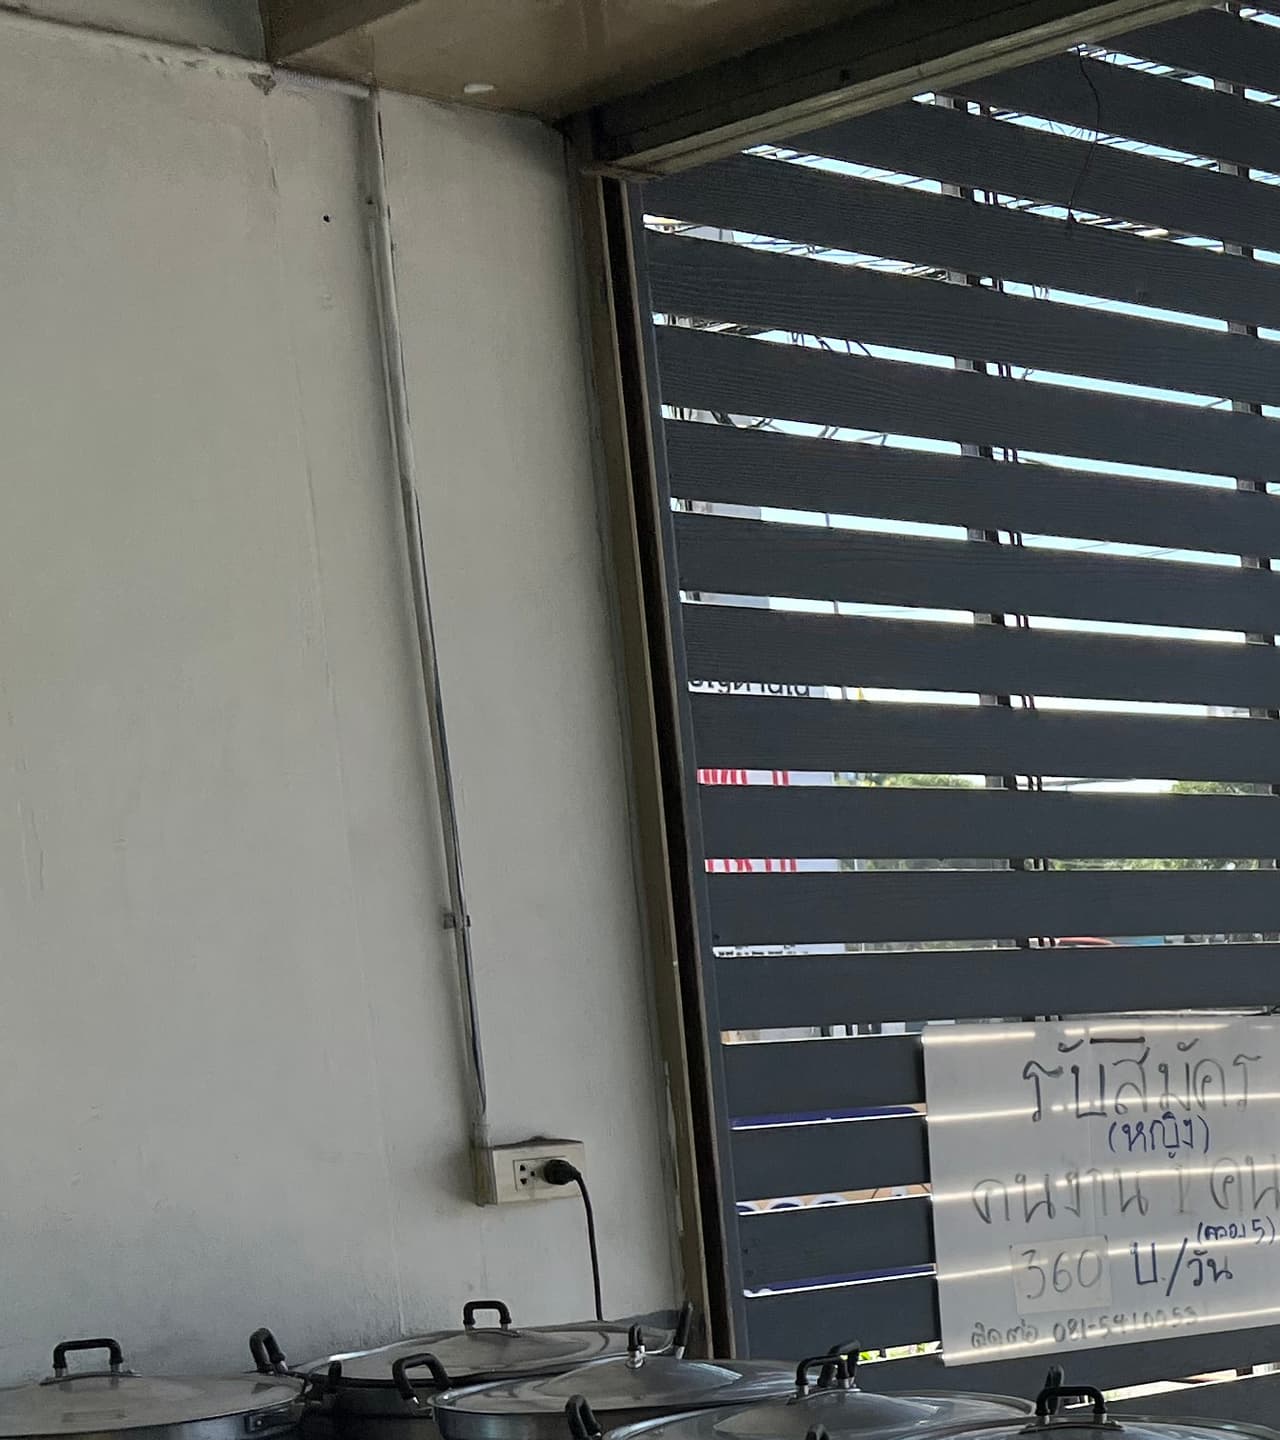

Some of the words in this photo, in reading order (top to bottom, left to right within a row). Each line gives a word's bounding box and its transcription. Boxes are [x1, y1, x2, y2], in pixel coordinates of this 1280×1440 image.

[1022, 1038, 1262, 1122] รับสมัคร
[1108, 1111, 1211, 1158] (หญิง)
[970, 1166, 1150, 1225] คนงาน
[1021, 1248, 1103, 1300] 360
